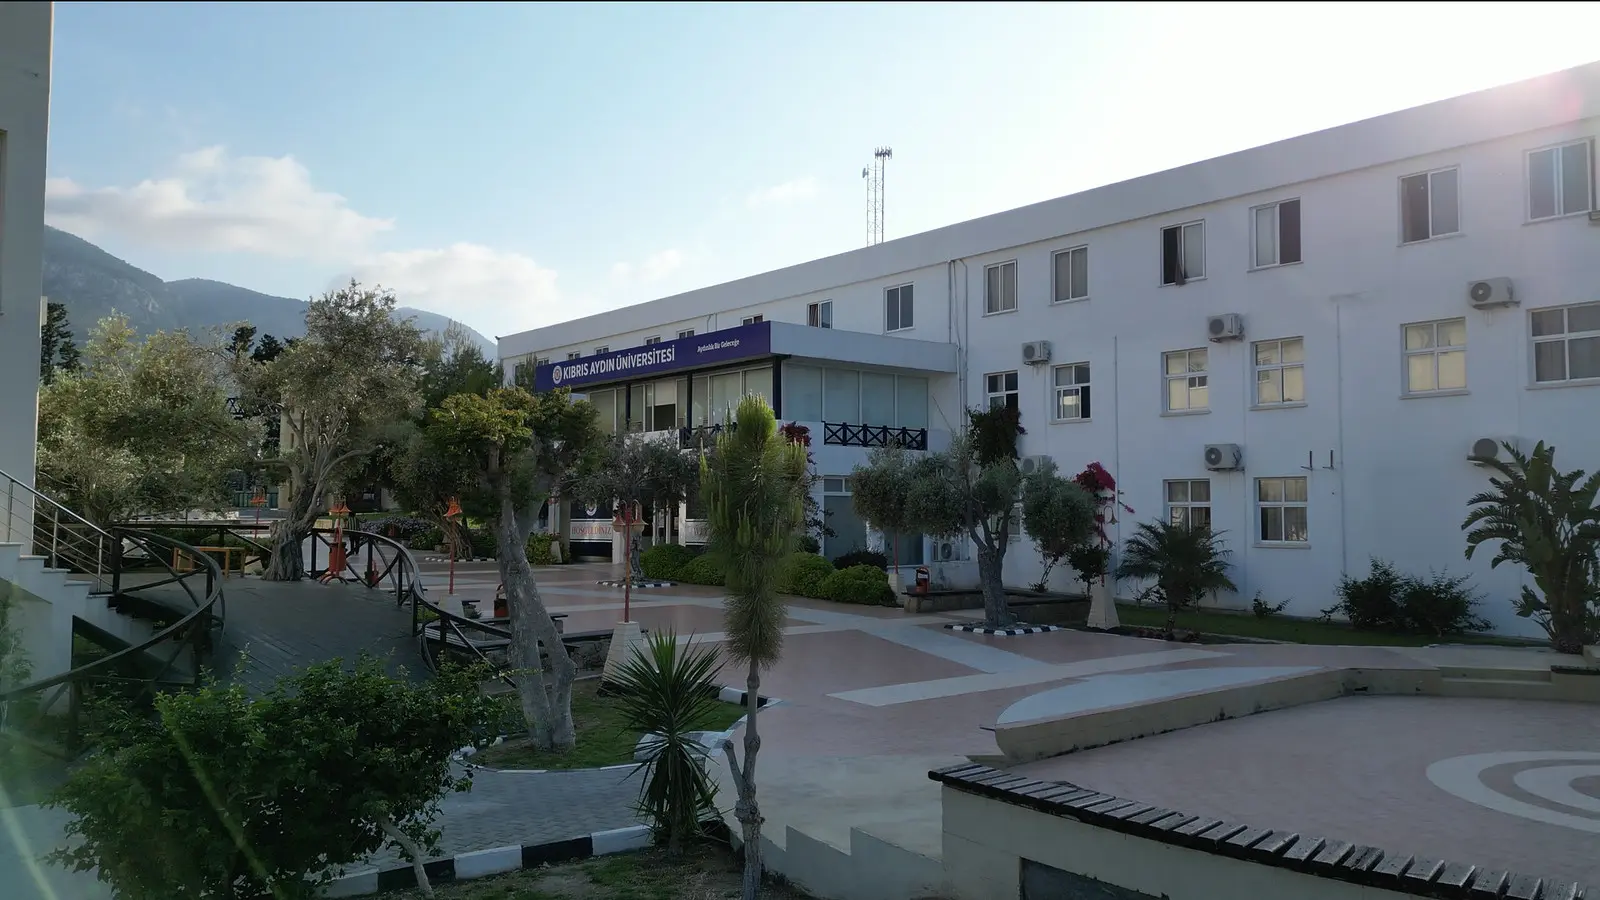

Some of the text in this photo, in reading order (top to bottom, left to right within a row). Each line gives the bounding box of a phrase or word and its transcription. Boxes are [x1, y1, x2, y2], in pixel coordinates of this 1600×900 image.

[563, 344, 675, 380] KIBRIS AYDIN ÜNİVERSİTESİ
